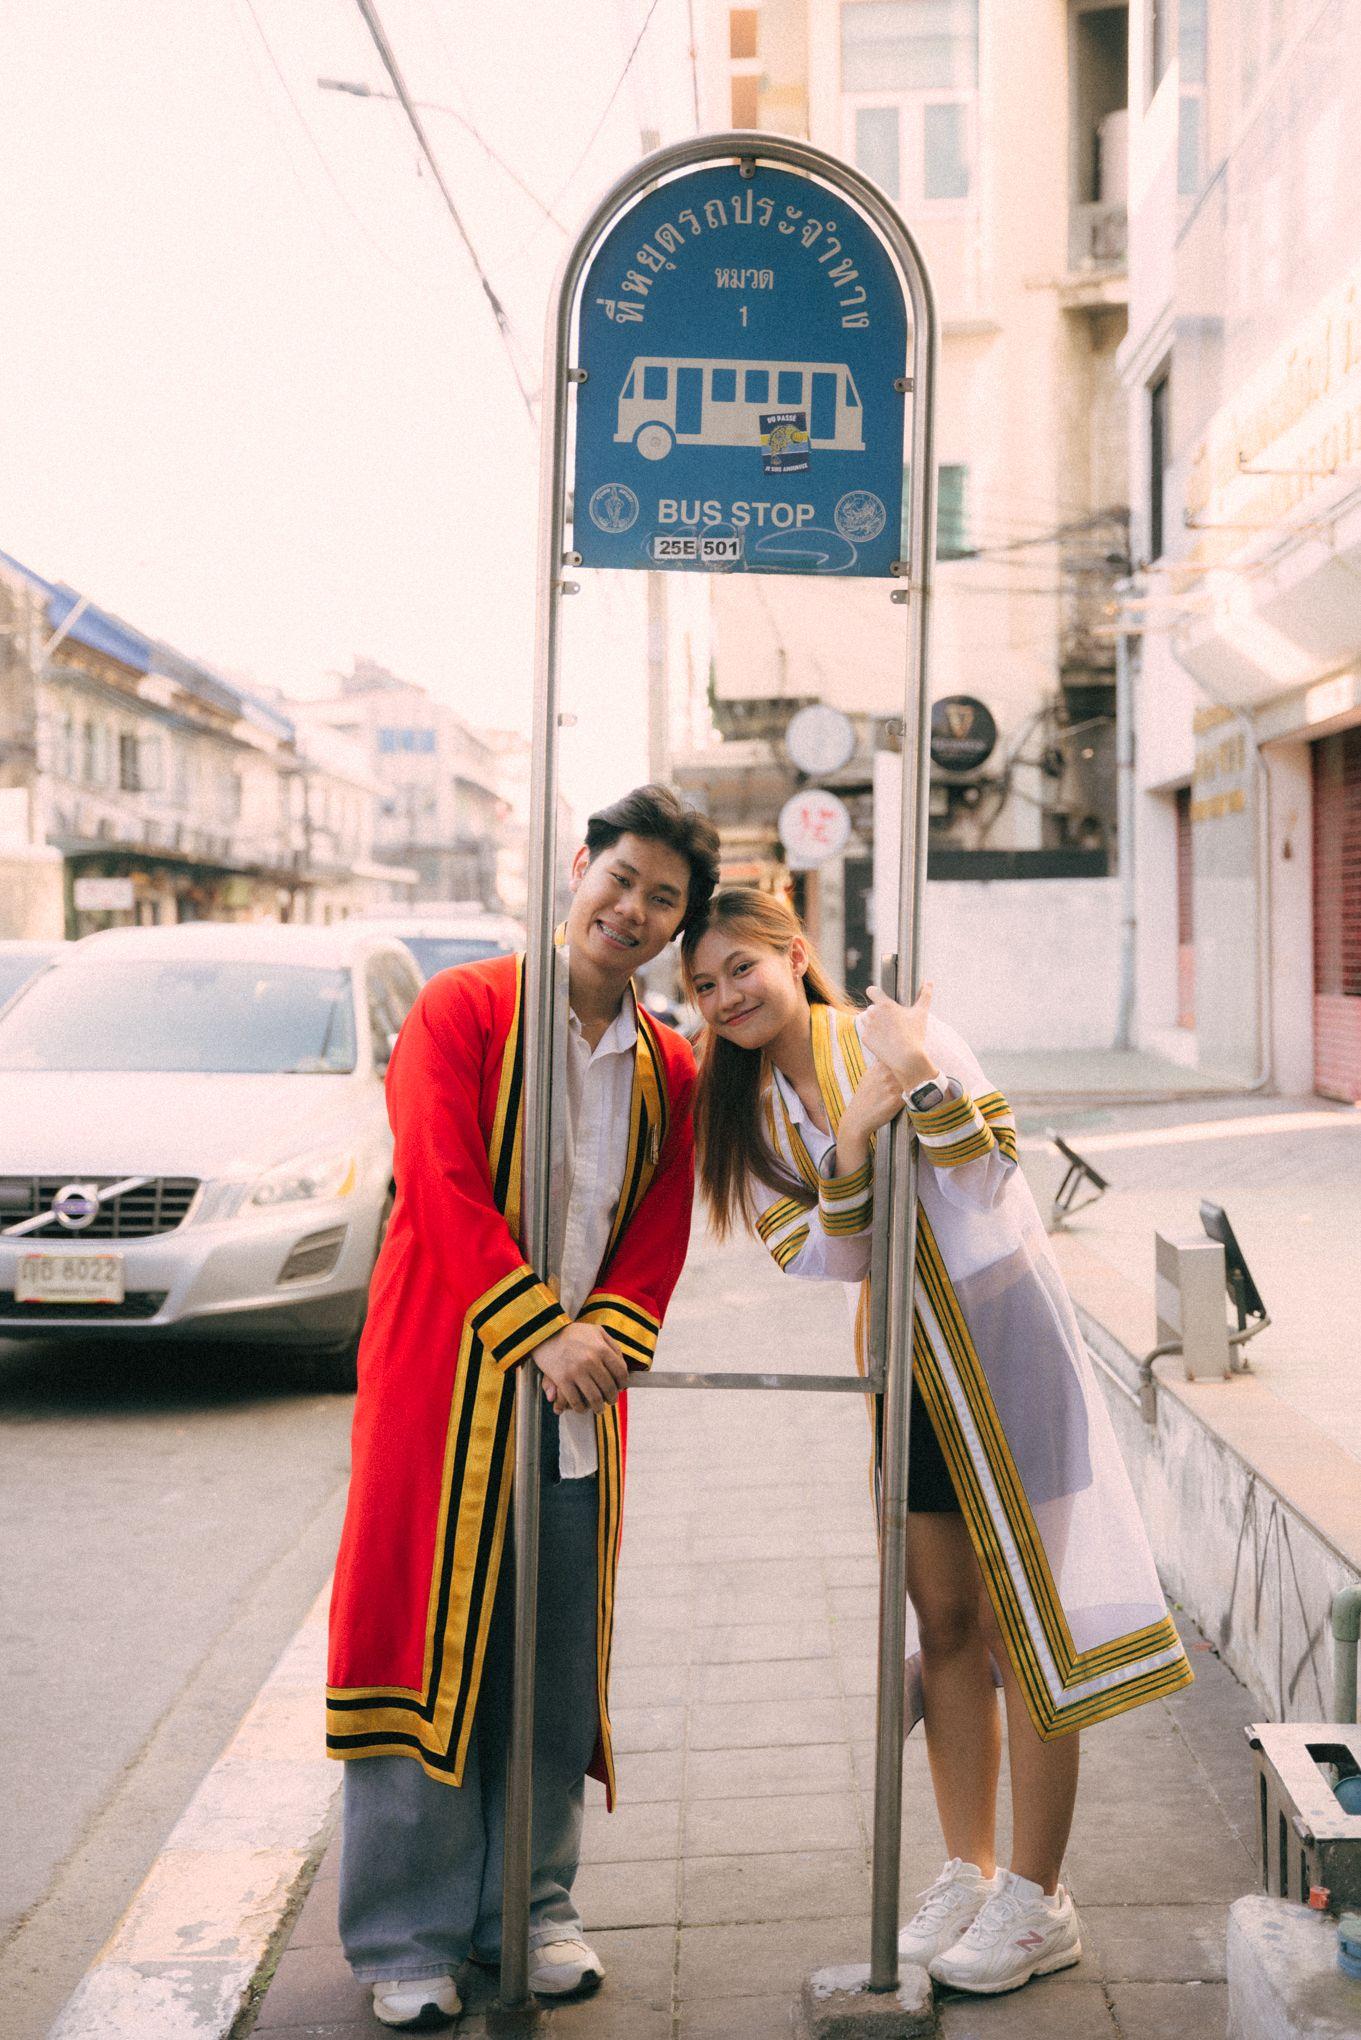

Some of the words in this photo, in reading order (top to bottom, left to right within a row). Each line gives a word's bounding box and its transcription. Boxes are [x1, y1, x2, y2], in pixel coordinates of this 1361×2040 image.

[597, 189, 870, 328] ที่หยุดรถประจำทาง
[715, 268, 774, 289] หมวด
[739, 306, 748, 328] 1
[658, 499, 722, 526] BUS
[731, 502, 815, 528] STOP
[659, 540, 696, 555] 25E
[703, 541, 738, 556] 501
